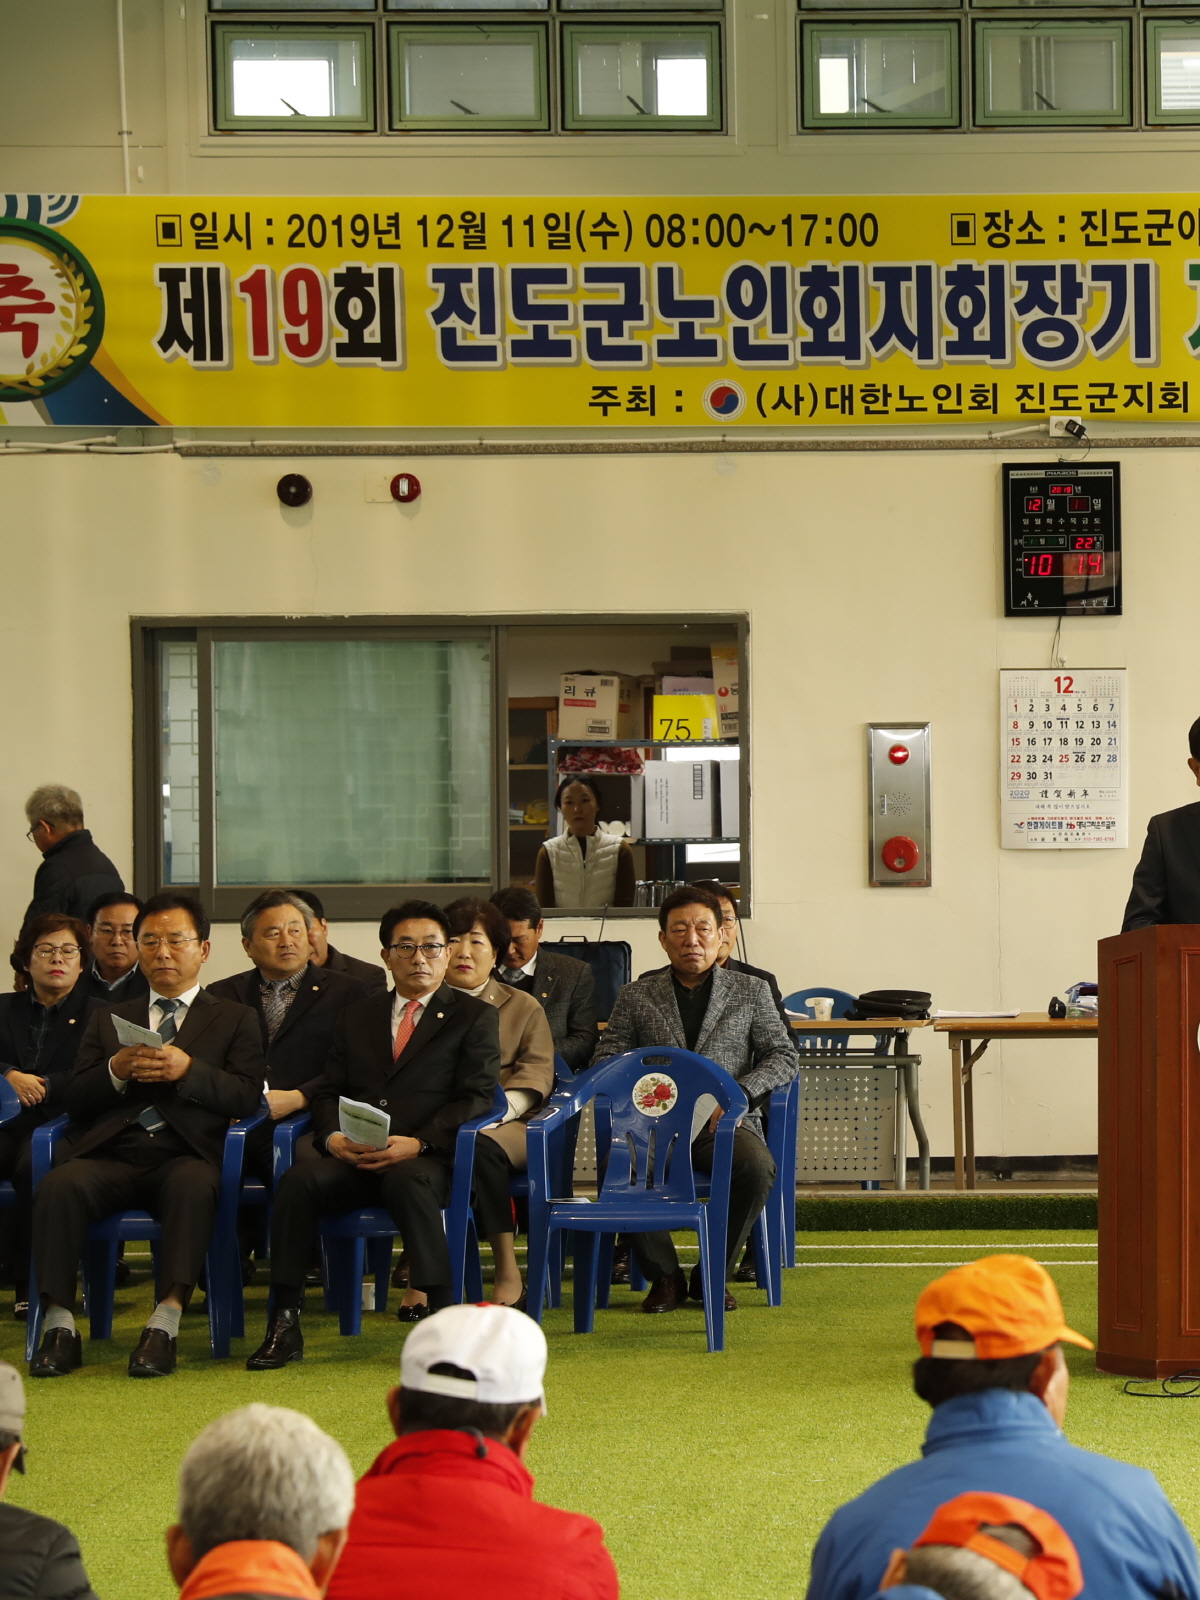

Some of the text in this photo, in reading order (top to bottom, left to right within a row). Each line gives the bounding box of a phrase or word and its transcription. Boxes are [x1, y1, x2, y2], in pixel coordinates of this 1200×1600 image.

[190, 212, 254, 252] 일시
[287, 211, 402, 250] 2019년
[417, 211, 487, 251] 12월
[501, 210, 634, 253] 11일(수)
[645, 212, 880, 249] 08:00~17:00
[982, 209, 1047, 248] 장소
[156, 264, 399, 364] 제19회
[429, 261, 1152, 364] 진도군노인회지회장기
[587, 384, 658, 418] 주최
[756, 381, 1000, 418] (사)대한노인회
[1014, 380, 1190, 416] 진도군지회
[1051, 486, 1072, 494] 2019
[1029, 499, 1041, 511] 12
[1046, 499, 1056, 511] 월
[1093, 498, 1102, 510] 일
[1075, 537, 1095, 549] 22
[1030, 554, 1102, 576] 10 14
[1054, 676, 1074, 694] 12
[660, 718, 691, 740] 75
[1043, 721, 1052, 729] 10
[1076, 721, 1084, 729] 12
[1012, 738, 1020, 746] 15
[1011, 755, 1020, 763] 22
[1027, 755, 1036, 763] 23
[1107, 754, 1117, 762] 28
[1011, 772, 1021, 780] 29
[1027, 772, 1037, 780] 30
